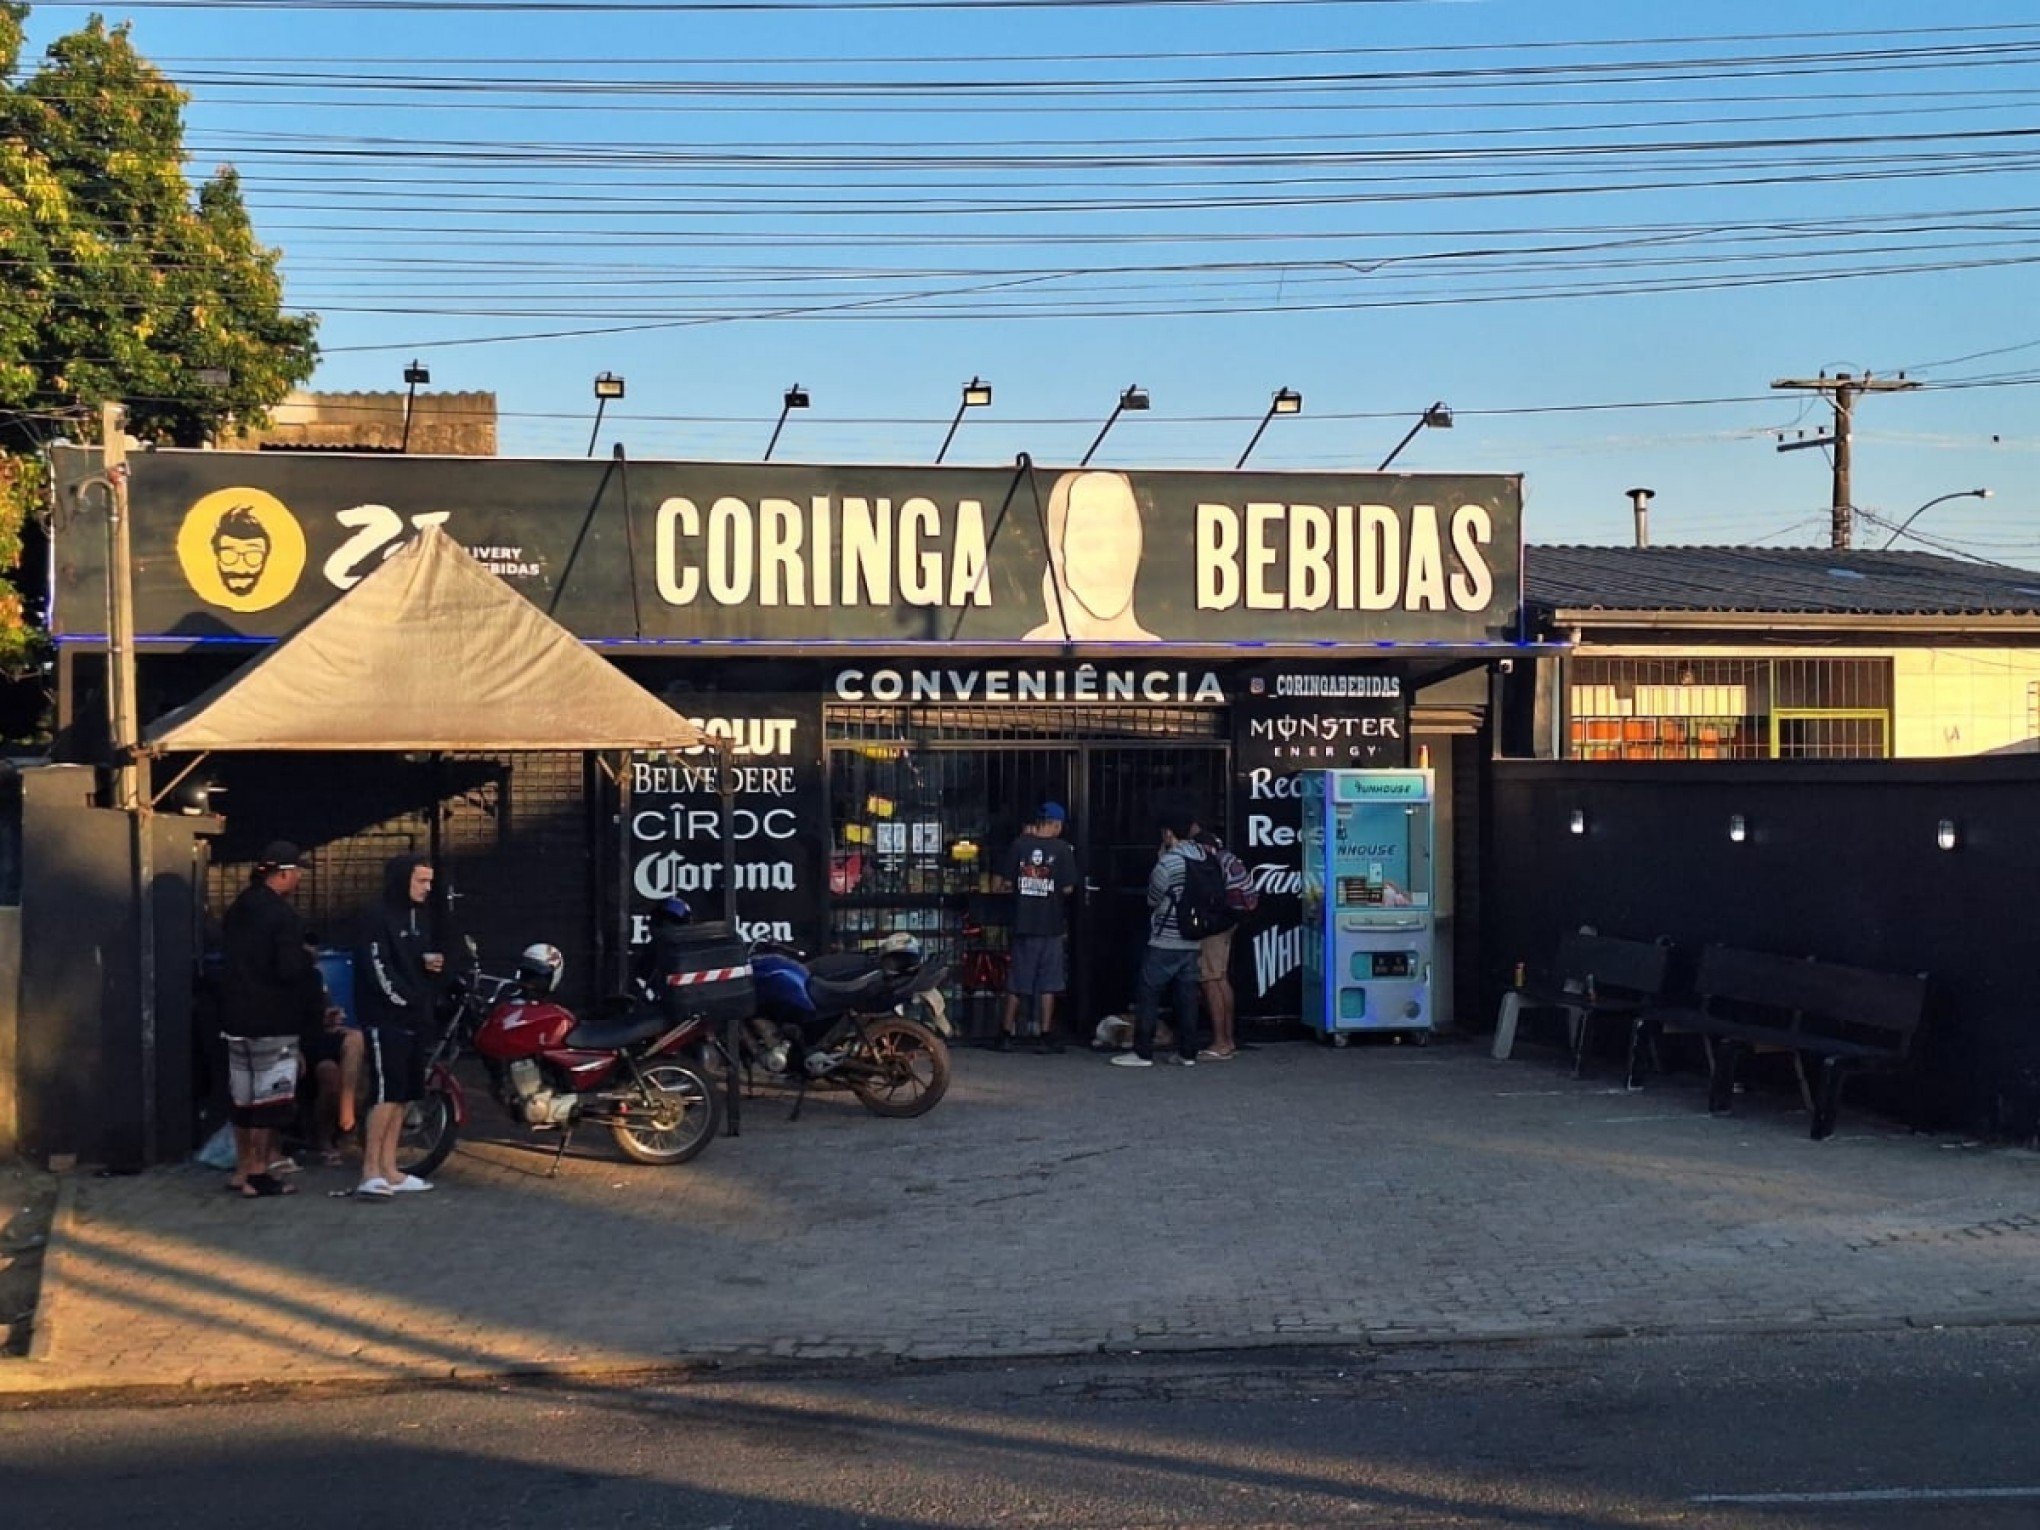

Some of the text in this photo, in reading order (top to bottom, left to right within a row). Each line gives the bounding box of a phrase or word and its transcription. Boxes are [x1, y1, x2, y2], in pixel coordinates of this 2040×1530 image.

[481, 562, 540, 575] BIDAS
[655, 495, 1492, 612] CORINGA BEBIDAS
[836, 663, 1225, 702] CONVENIÊNCIA
[1250, 713, 1400, 742] MONSTER
[1274, 746, 1377, 757] ENERGY
[632, 803, 797, 841] CÎROC
[631, 915, 794, 945] Hken
